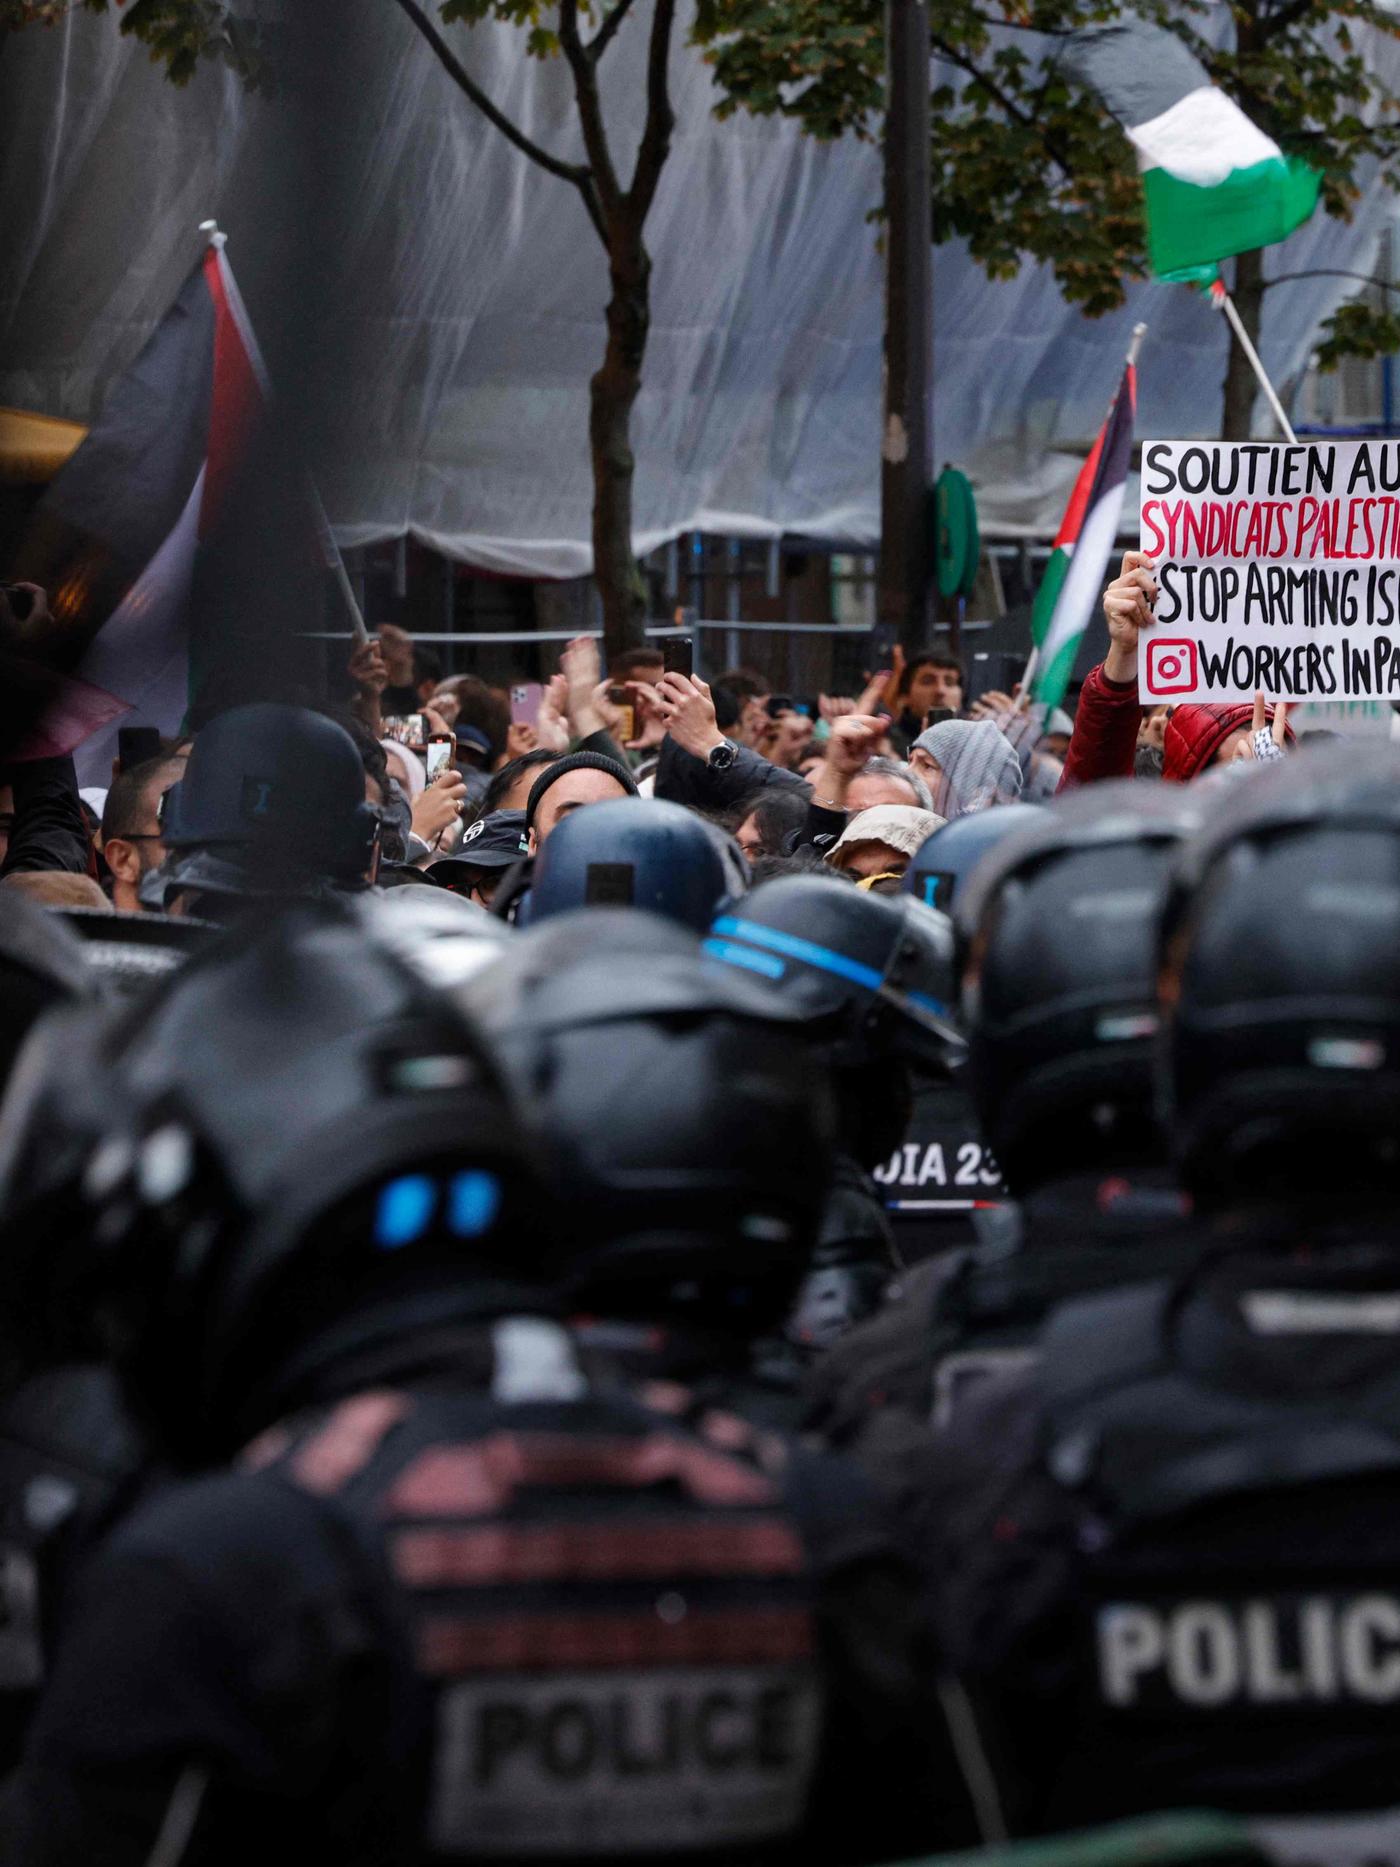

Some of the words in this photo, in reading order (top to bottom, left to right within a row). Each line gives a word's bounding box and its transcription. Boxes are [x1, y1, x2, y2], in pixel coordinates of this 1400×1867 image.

[1146, 443, 1336, 496] SOUTIEN
[1141, 499, 1293, 559] SYNDICATS
[1197, 637, 1337, 695] WORKERS
[471, 1686, 798, 1786] POLICE
